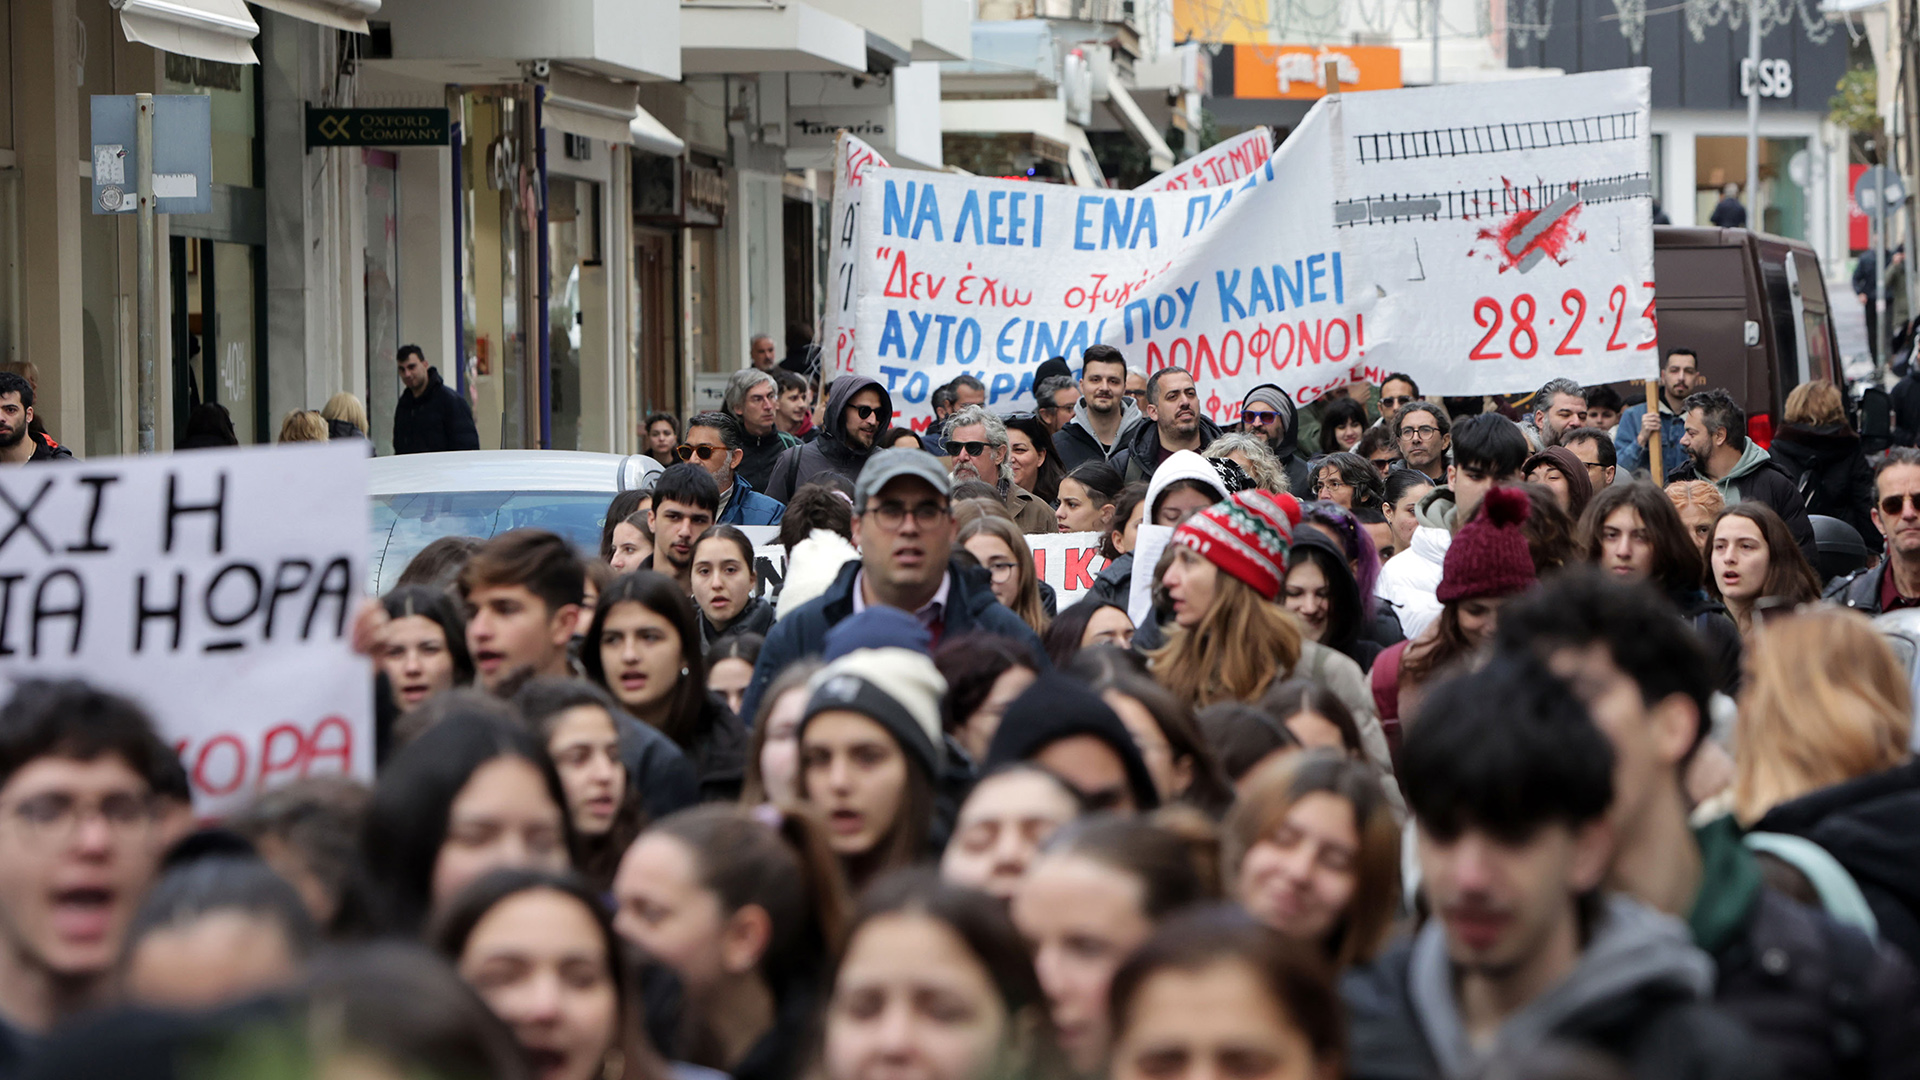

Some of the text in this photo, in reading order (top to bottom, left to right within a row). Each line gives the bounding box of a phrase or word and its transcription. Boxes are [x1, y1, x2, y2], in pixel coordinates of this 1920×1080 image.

[360, 114, 430, 127] OXFORD
[360, 128, 441, 140] COMPANY
[883, 179, 943, 242] ΝΑ
[953, 189, 1044, 248] ΛΕΕΙ
[1073, 194, 1158, 251] ΕΝΑ
[955, 261, 1033, 308] έχω
[878, 309, 982, 366] ΑΥΤΟ
[996, 316, 1107, 365] ΕΙΝΑΙ
[1123, 280, 1201, 345] ΠΟΥ
[1215, 251, 1344, 324] ΚΑΝΕΙ
